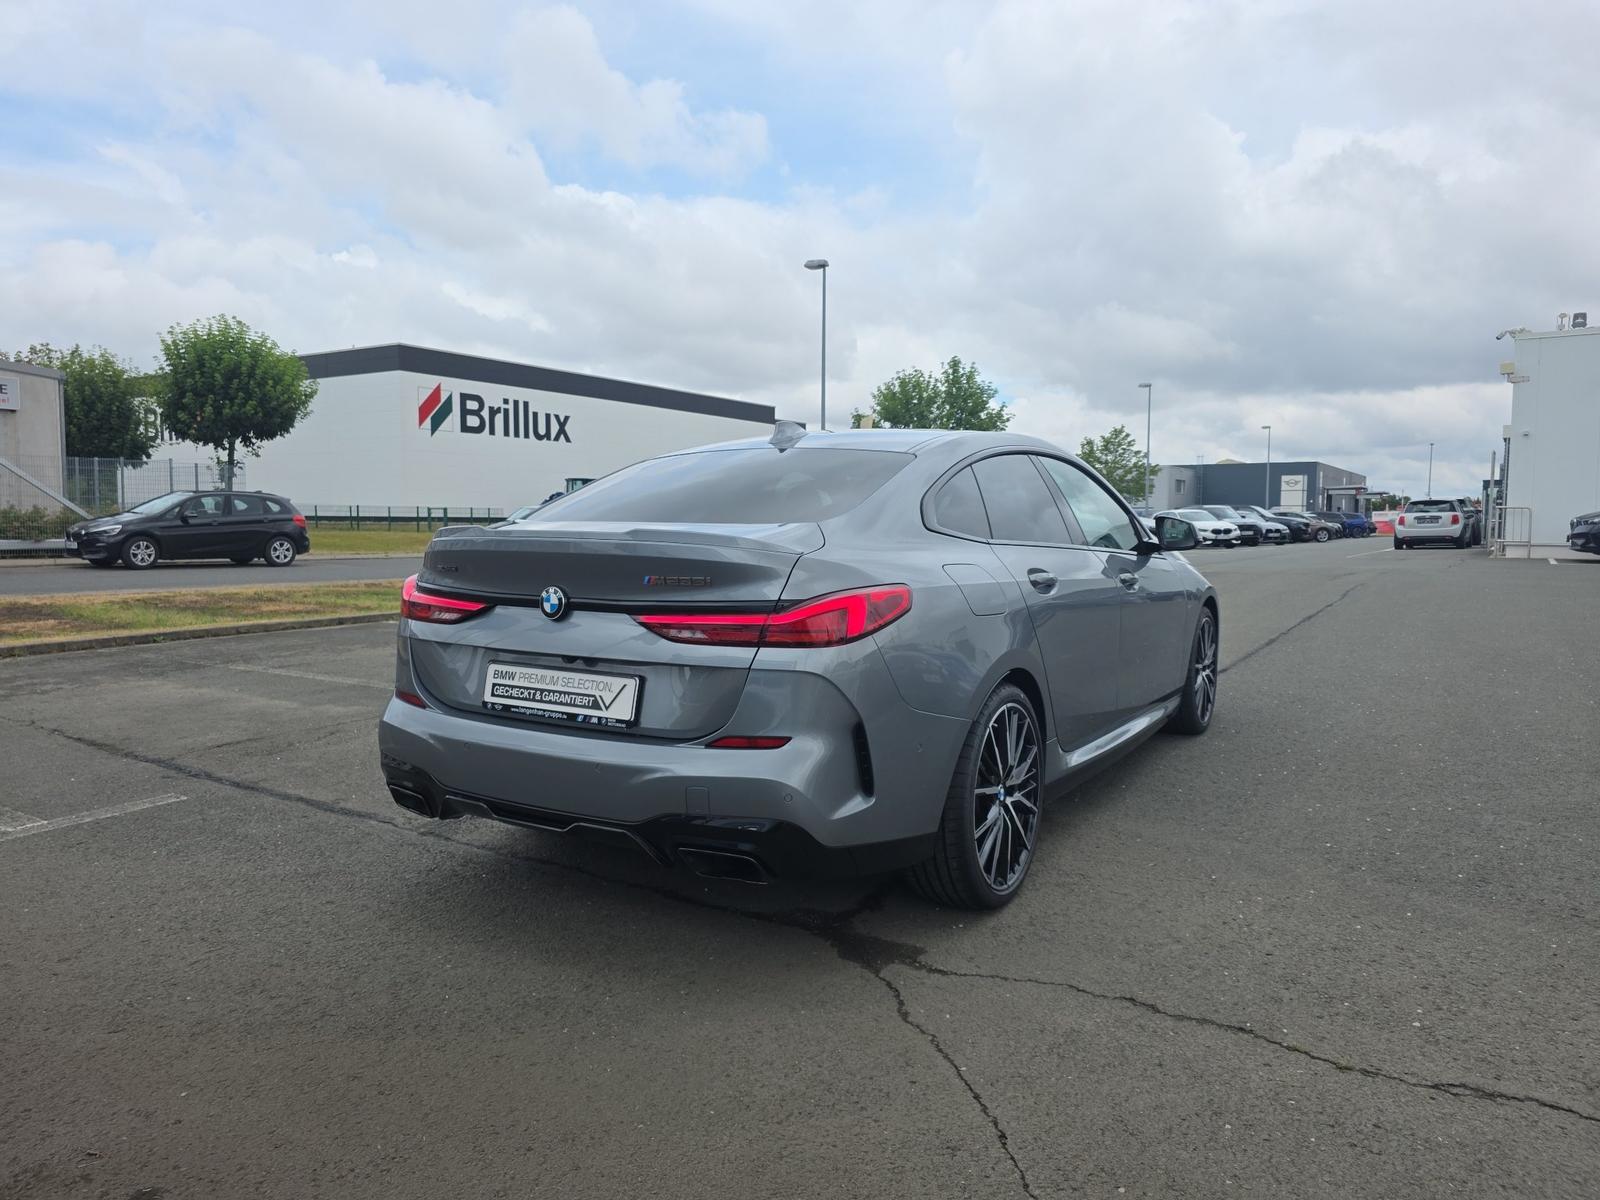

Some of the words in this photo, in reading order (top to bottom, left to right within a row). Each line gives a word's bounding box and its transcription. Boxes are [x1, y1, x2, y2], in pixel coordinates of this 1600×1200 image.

[459, 392, 572, 443] Brillux
[493, 669, 517, 681] BMW
[518, 672, 560, 687] PREMIUM
[561, 677, 614, 693] SELECTION.
[493, 686, 534, 699] GECHECKT
[535, 691, 541, 700] &
[542, 693, 595, 706] GARANTIERT
